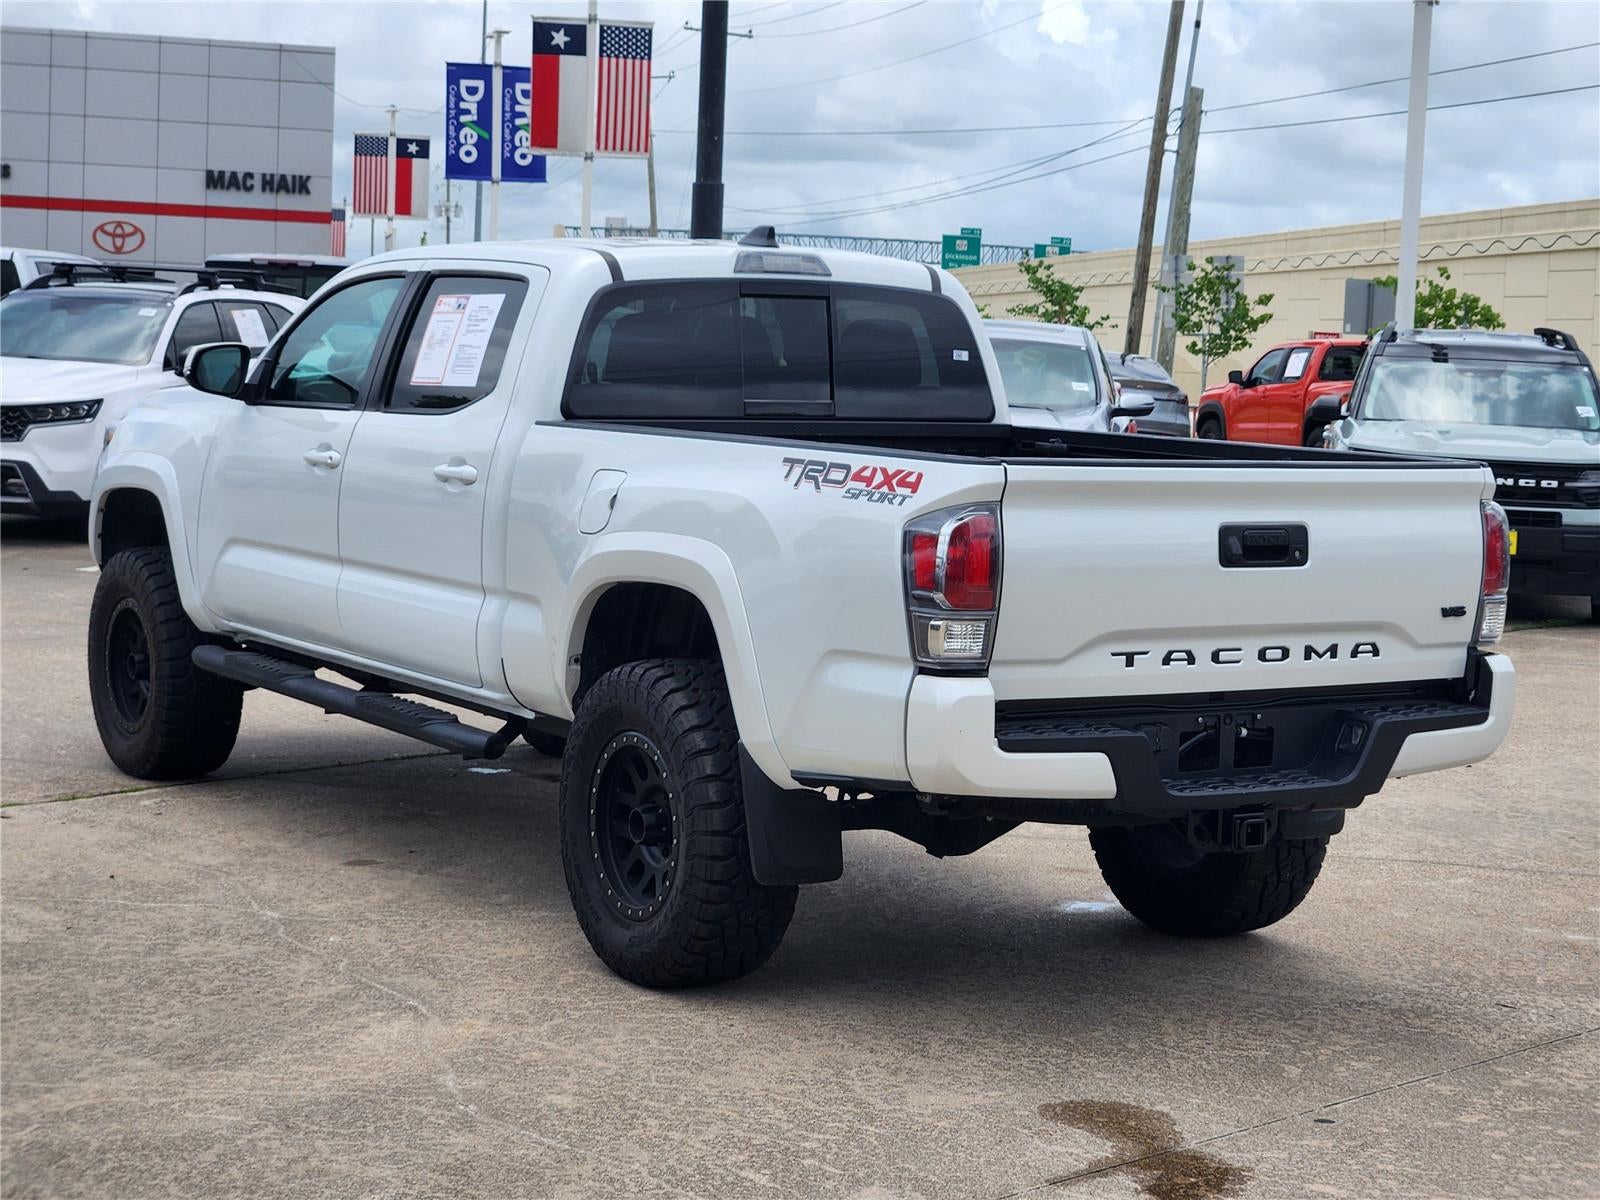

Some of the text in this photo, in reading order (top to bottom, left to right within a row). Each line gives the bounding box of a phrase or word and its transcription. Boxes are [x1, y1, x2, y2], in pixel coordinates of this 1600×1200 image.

[448, 85, 457, 109] Cruise
[504, 88, 512, 111] Cruise
[448, 119, 457, 139] Cash
[504, 122, 512, 141] Cash
[206, 169, 312, 195] MAC HAIK
[782, 457, 924, 494] TRD 4X4
[1496, 478, 1558, 488] NCO
[841, 487, 914, 506] SPORT
[1440, 606, 1467, 618] V6
[1110, 641, 1381, 668] TACOMA
